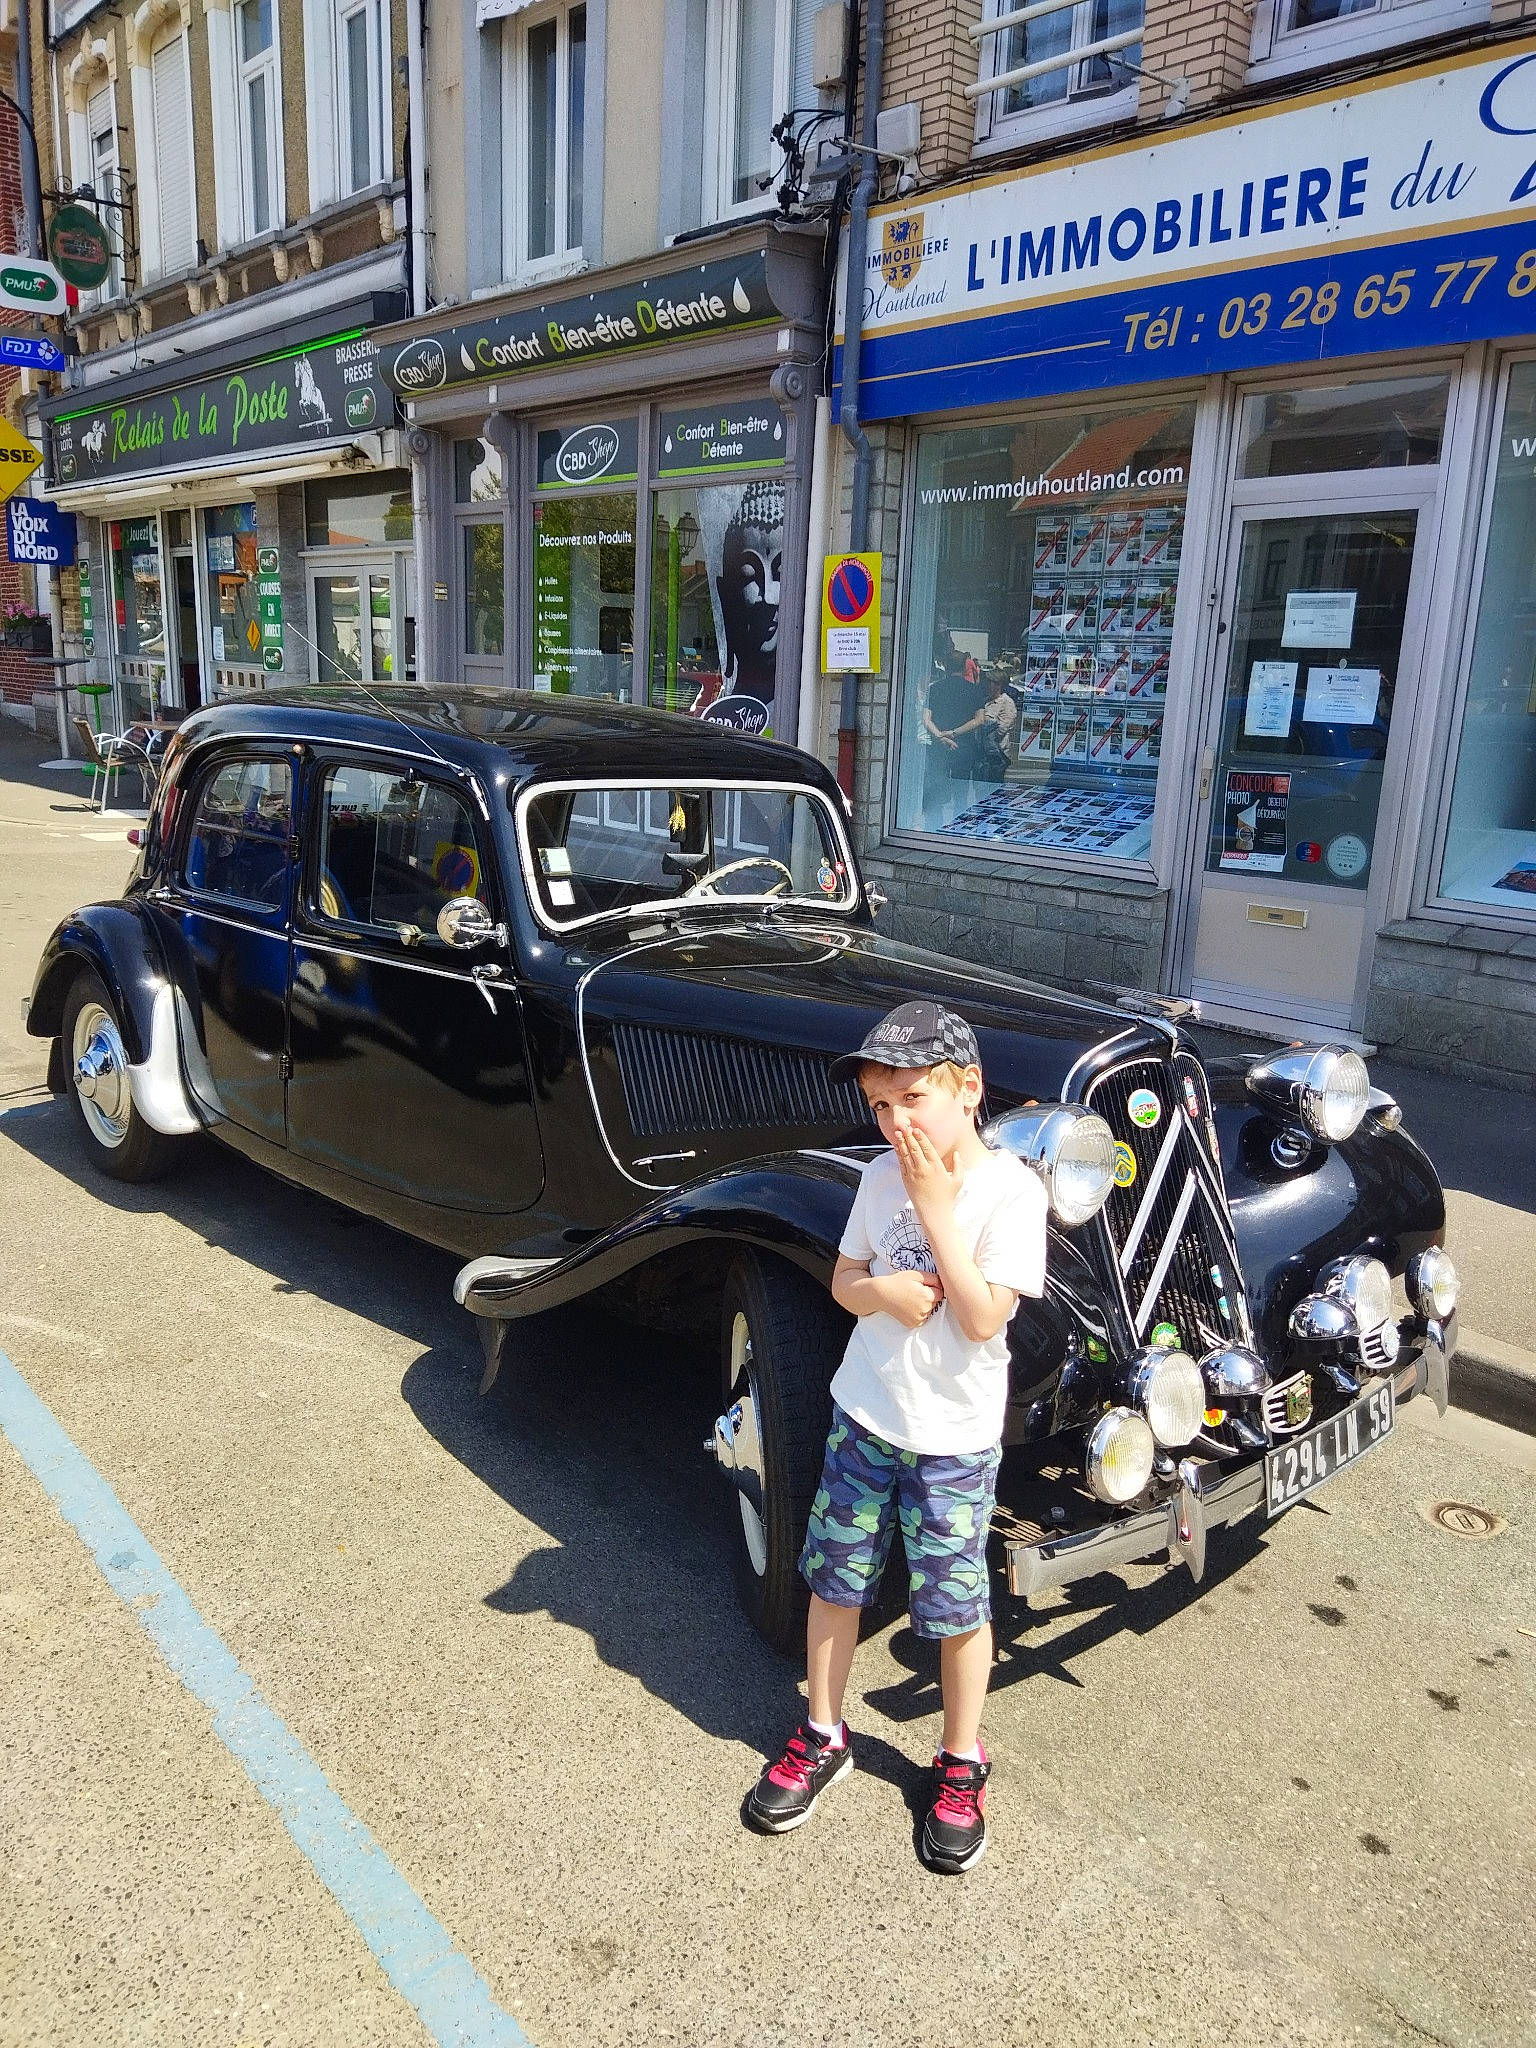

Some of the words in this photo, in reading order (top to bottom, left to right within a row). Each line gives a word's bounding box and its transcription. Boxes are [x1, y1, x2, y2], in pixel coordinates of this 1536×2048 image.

[967, 156, 1370, 292] L'IMMOBILIERE
[1390, 139, 1477, 211] du
[863, 237, 949, 270] 'IMMOBILIERE
[5, 276, 33, 292] PMU
[861, 279, 949, 322] Houtland
[1123, 305, 1184, 354] Tél
[1217, 292, 1272, 340] 03
[1281, 281, 1342, 330] 28
[1353, 268, 1416, 319] 65
[1429, 255, 1499, 309] 77
[1507, 249, 1536, 298] 8
[475, 331, 545, 368] Confort
[547, 312, 638, 353] Bien-être
[636, 291, 728, 335] Détente
[5, 339, 33, 355] FDJ
[343, 361, 373, 385] PRESSE
[400, 366, 425, 385] CBD
[418, 350, 443, 379] Shop
[348, 402, 364, 417] PMU
[111, 408, 165, 464] Relais
[172, 396, 190, 441] de
[198, 392, 217, 436] la
[226, 375, 288, 447] Poste
[676, 423, 715, 442] Confort
[720, 416, 769, 437] Bien-être
[562, 451, 587, 472] CBD
[587, 436, 615, 467] Shop
[702, 440, 744, 459] Détente
[920, 464, 1185, 505] www.immduhoutland.com
[10, 501, 29, 517] LA
[11, 516, 49, 533] VOIX
[129, 525, 149, 542] Jouez!
[13, 530, 36, 545] DU
[539, 533, 581, 547] Découvrez
[583, 533, 597, 545] nos
[598, 530, 632, 545] Produits
[13, 543, 59, 561] NORD
[259, 582, 281, 596] COURSES
[267, 603, 275, 617] EN
[264, 623, 281, 637] DIRECT
[734, 707, 764, 735] Shop
[1230, 774, 1275, 793] CONCOUR
[1227, 791, 1250, 805] PHOTO
[1271, 1432, 1327, 1503] 4294
[1369, 1388, 1391, 1440] 59
